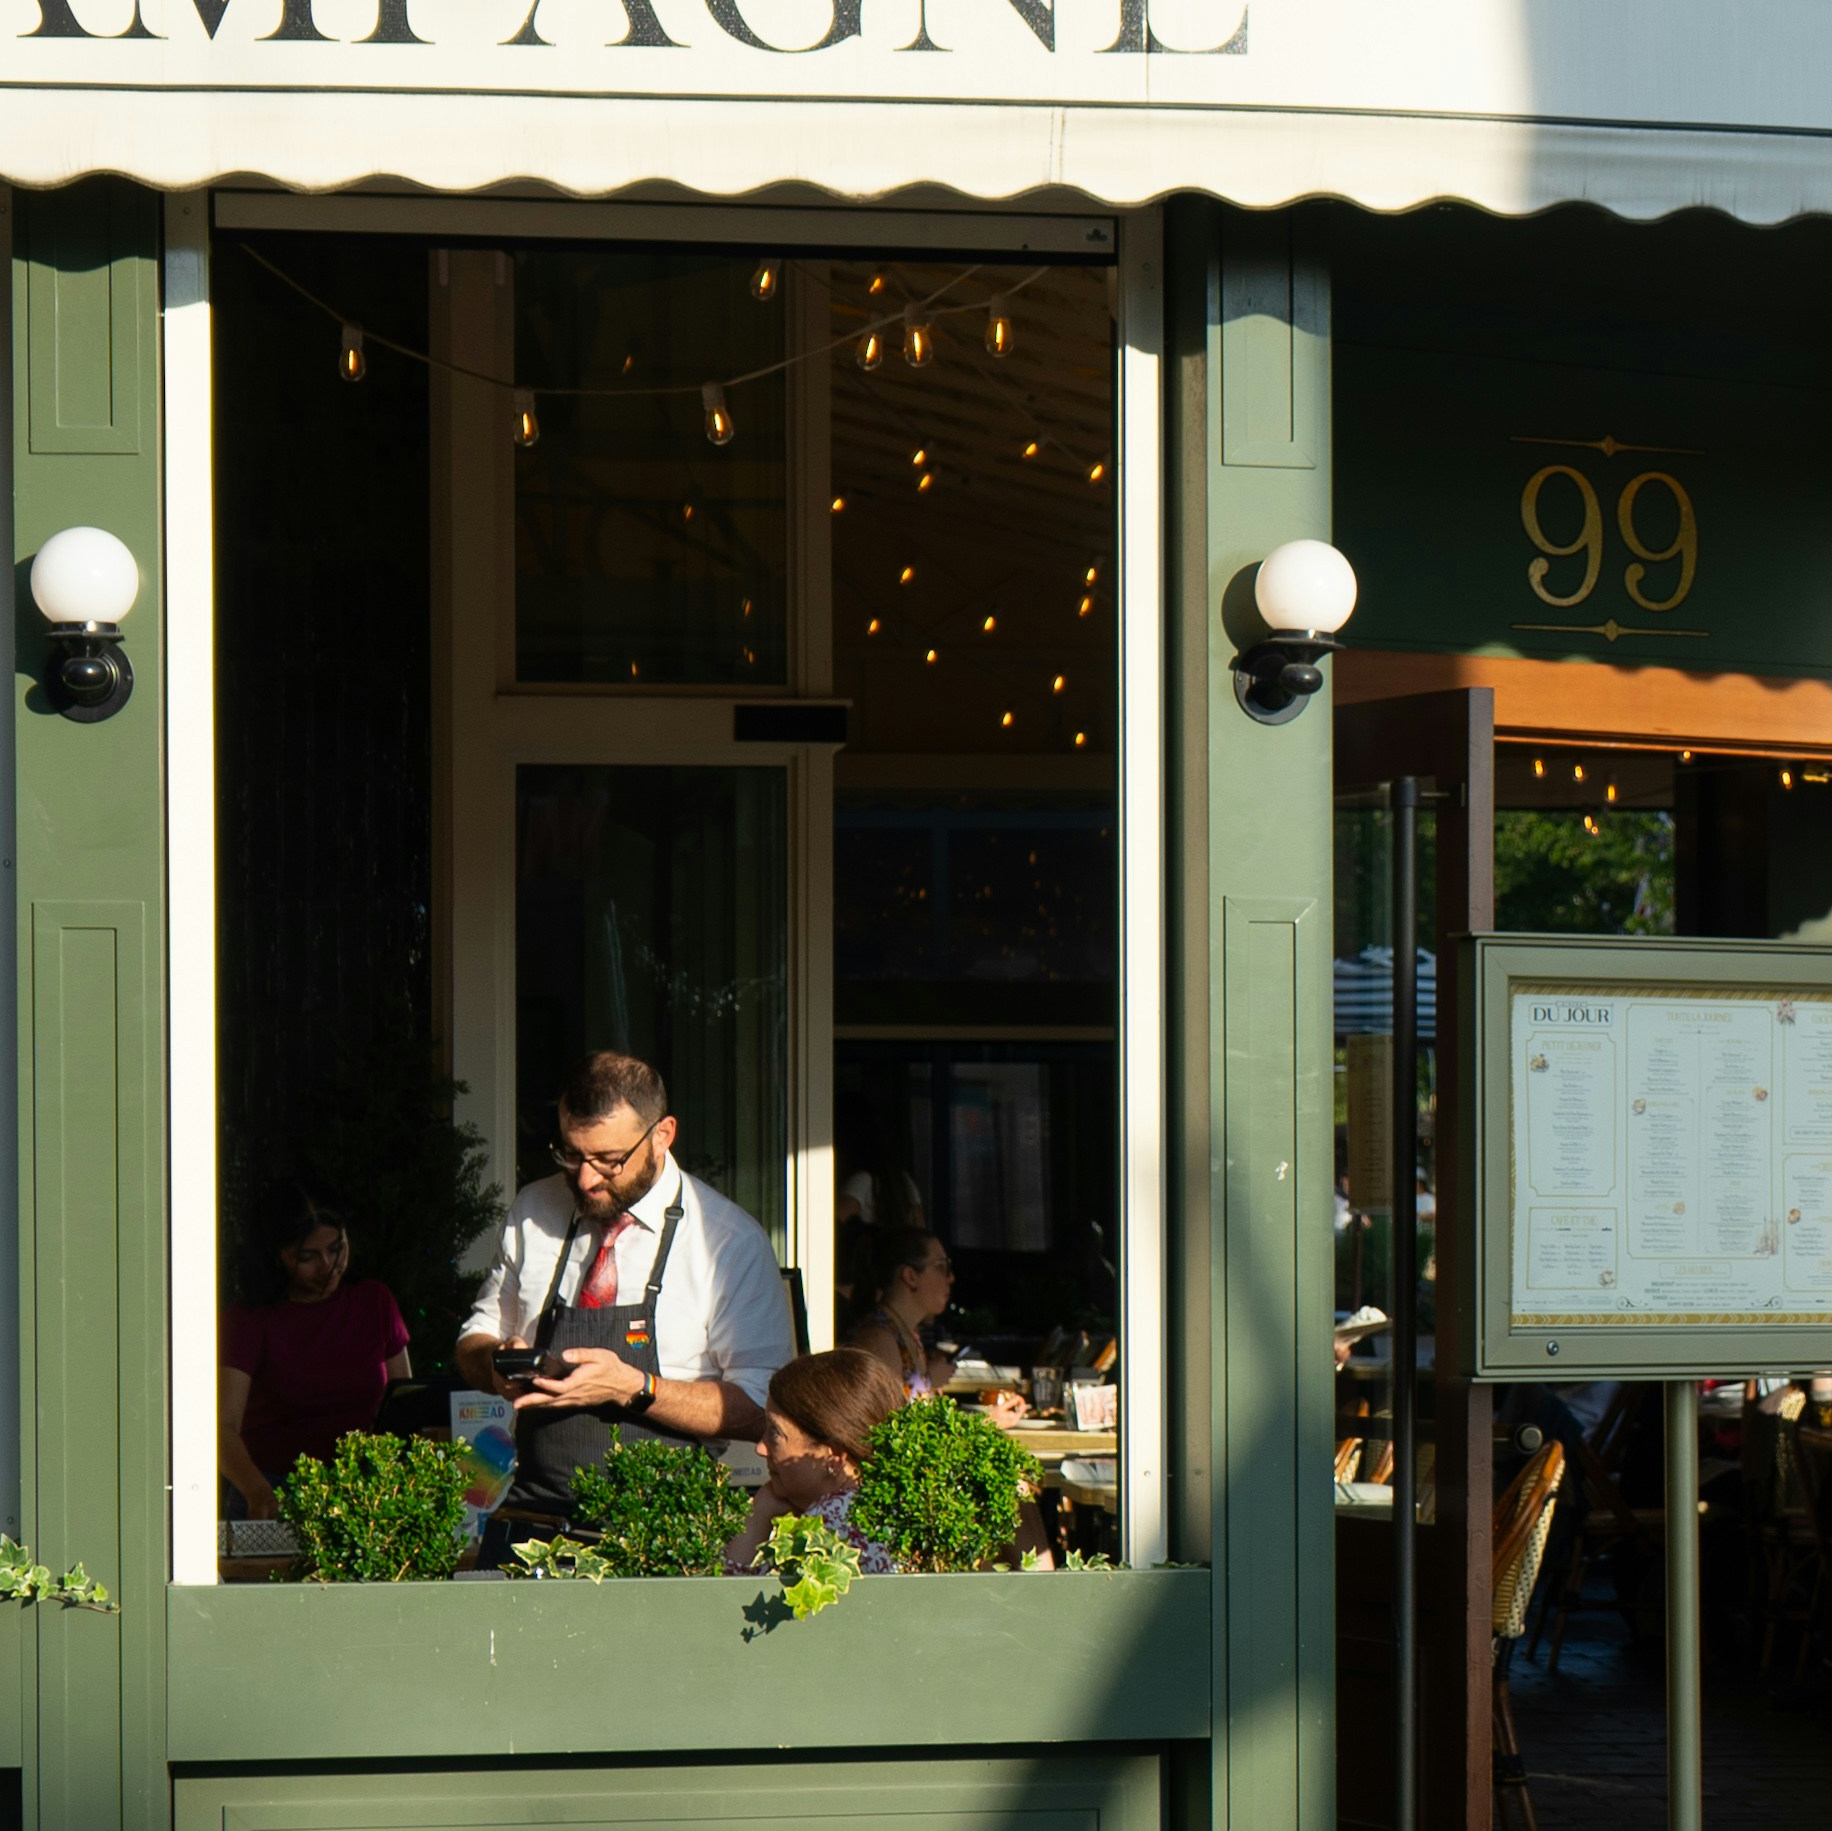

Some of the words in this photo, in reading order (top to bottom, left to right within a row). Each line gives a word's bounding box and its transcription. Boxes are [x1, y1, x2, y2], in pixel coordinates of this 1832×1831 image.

[1520, 464, 1699, 612] 99
[1533, 1007, 1560, 1022] DU
[1562, 1007, 1610, 1023] JOUR
